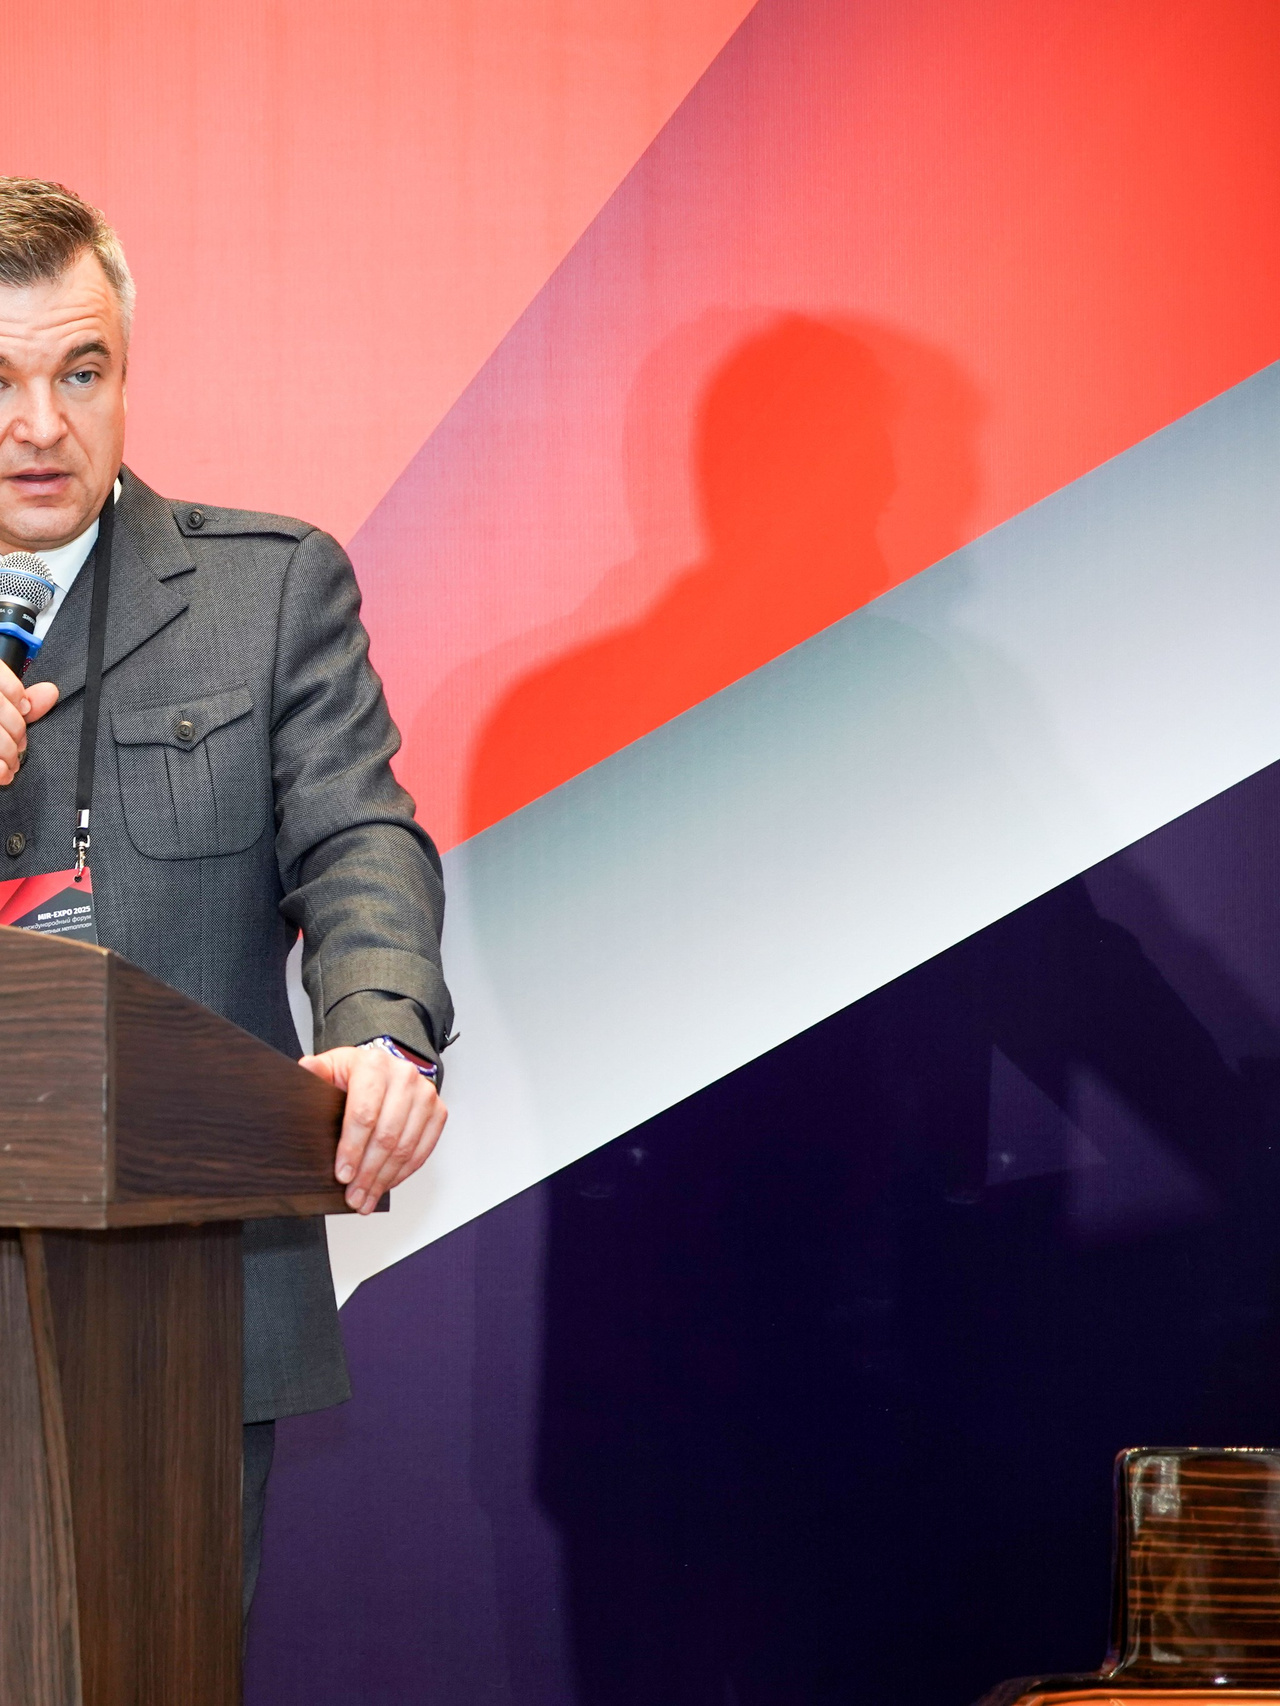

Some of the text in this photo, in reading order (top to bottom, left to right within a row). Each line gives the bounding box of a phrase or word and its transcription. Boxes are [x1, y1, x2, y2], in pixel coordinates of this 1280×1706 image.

[37, 905, 91, 921] MIR-EXPO 2025
[71, 914, 92, 924] форум
